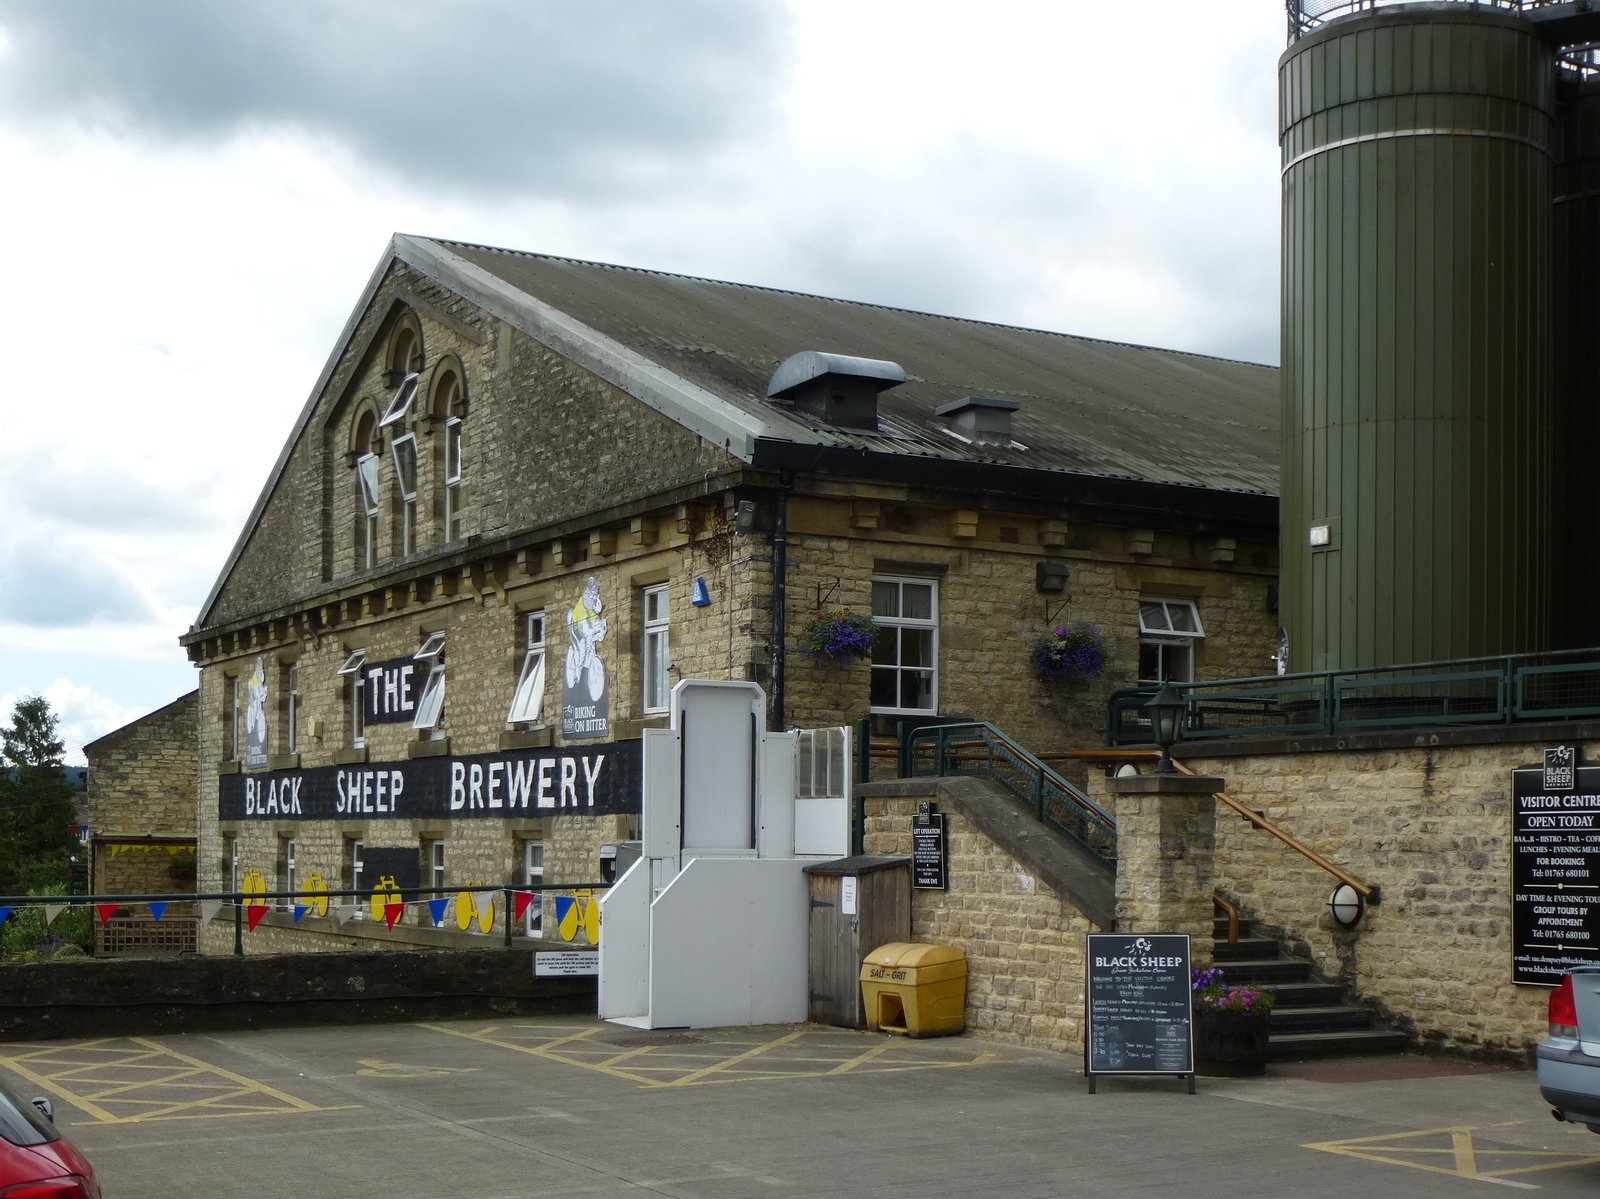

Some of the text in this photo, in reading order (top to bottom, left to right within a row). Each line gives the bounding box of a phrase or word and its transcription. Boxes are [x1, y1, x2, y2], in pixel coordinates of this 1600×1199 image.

[368, 665, 414, 715] THE
[574, 706, 596, 719] BIKING
[574, 718, 607, 732] ON BITTER
[1546, 766, 1571, 775] BLACK
[1546, 775, 1571, 783] SHEEP
[246, 755, 605, 815] BLACK SHEEP BREWERY
[1520, 794, 1600, 808] VISITOR CENTRE
[1528, 815, 1595, 828] OPEN TODAY
[1550, 858, 1585, 866] BOOKINGS
[1532, 869, 1590, 878] Tel: 01765 680101
[1530, 894, 1545, 902] TIME
[1554, 895, 1584, 903] EVENING
[1534, 906, 1556, 914] GROUP
[1557, 906, 1578, 914] TOURS
[1538, 918, 1584, 926] APPOINTMENT
[1532, 930, 1590, 940] Tel: 01765 680100
[1096, 957, 1182, 966] BLACK SHEEP
[870, 969, 906, 980] SALT GRIT
